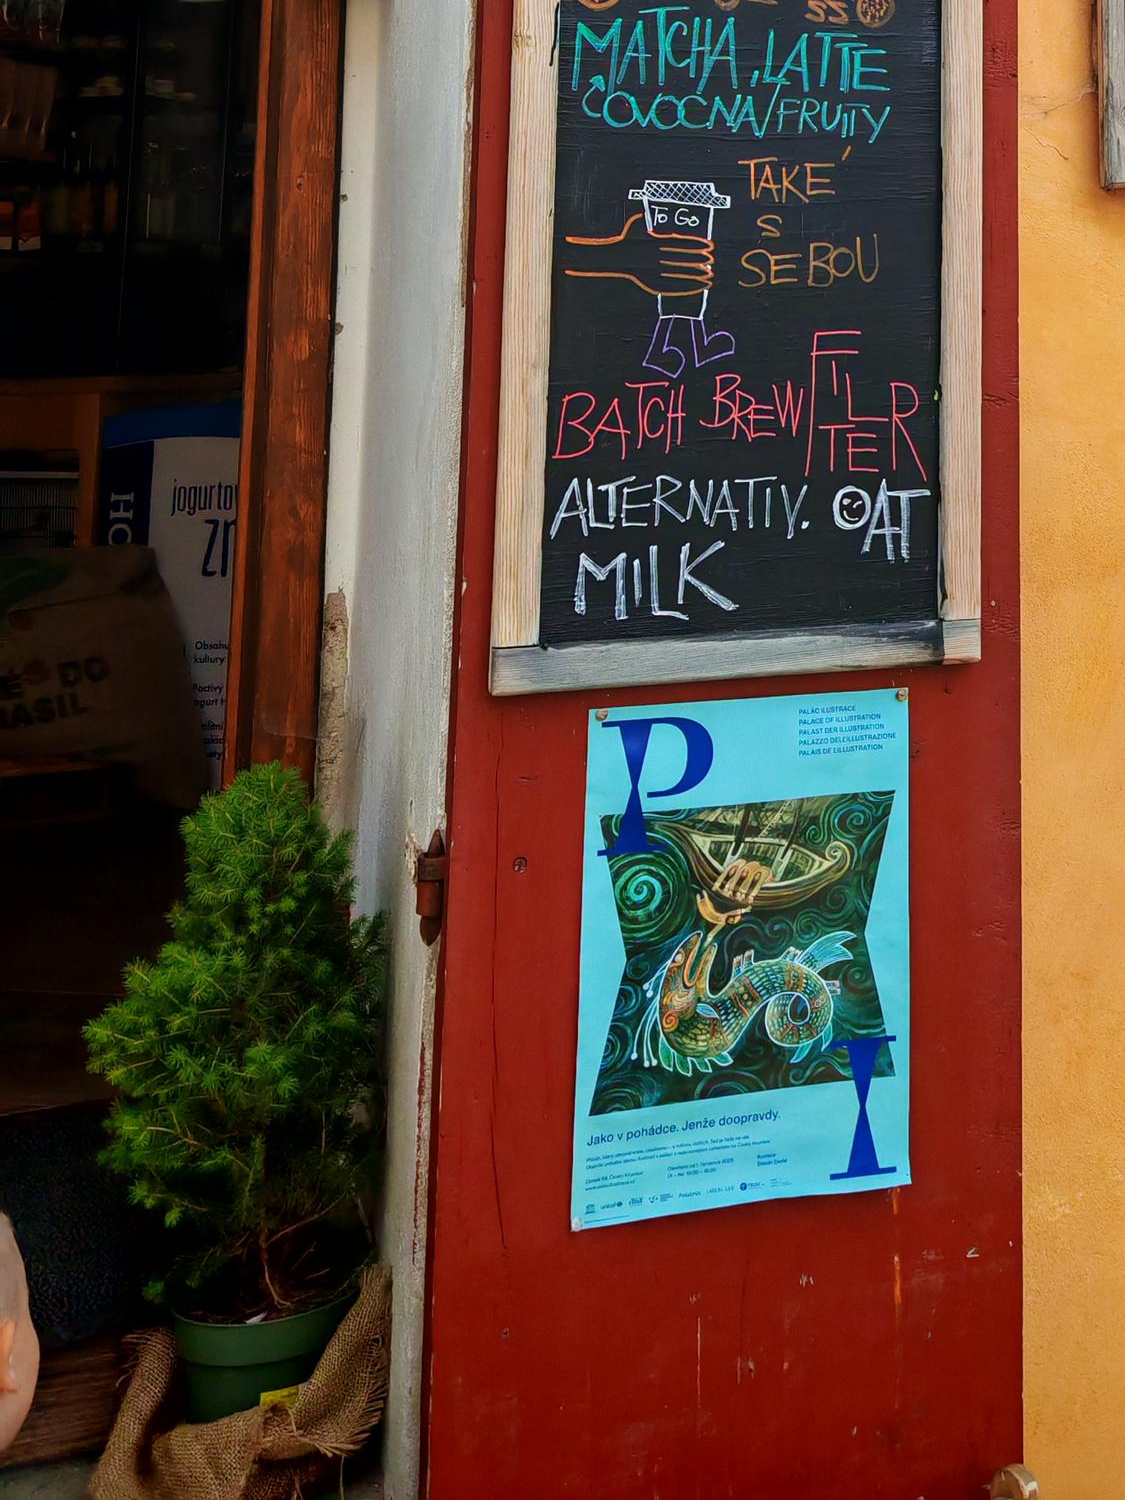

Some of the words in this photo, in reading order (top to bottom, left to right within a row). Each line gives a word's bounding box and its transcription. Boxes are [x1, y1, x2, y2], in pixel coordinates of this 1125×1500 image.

[651, 205, 668, 226] To
[674, 208, 700, 227] Go
[755, 213, 783, 238] S
[552, 381, 685, 461] BATCH
[699, 373, 804, 443] BREW
[171, 478, 237, 516] jogurto
[550, 475, 810, 540] ALTERNATIV.
[832, 478, 931, 564] OAT
[573, 539, 740, 621] MILK
[798, 717, 825, 726] PALACE
[597, 716, 714, 857] P
[587, 1133, 614, 1147] Jako
[617, 1132, 624, 1141] v
[626, 1122, 680, 1142] pohádce.
[681, 1116, 716, 1132] Jenže
[718, 1109, 781, 1127] doopravdy.
